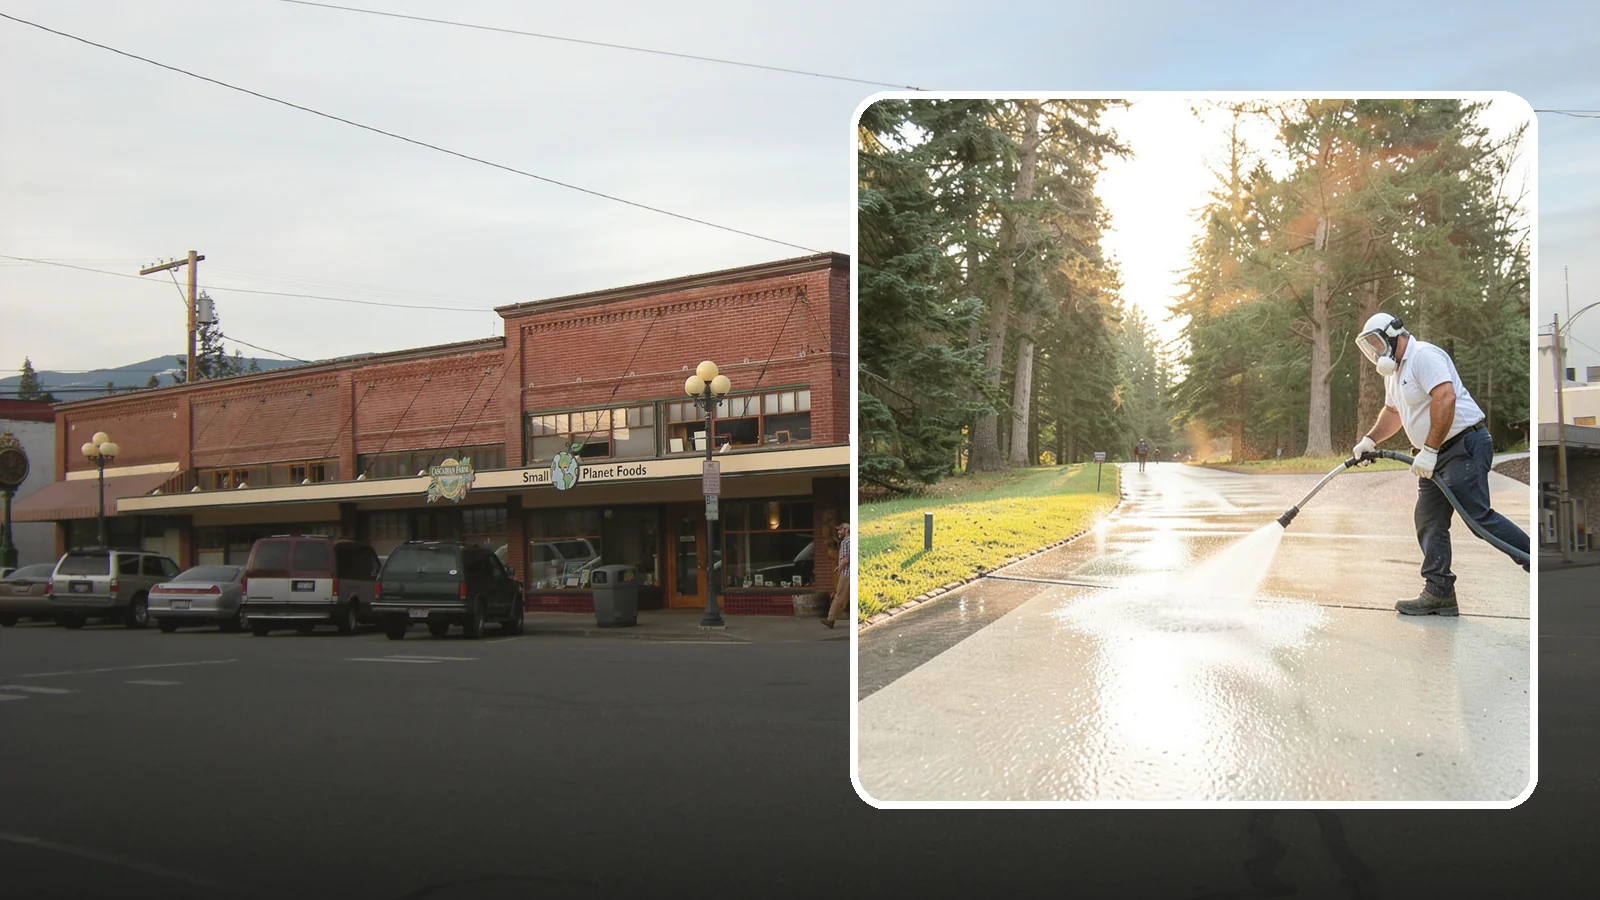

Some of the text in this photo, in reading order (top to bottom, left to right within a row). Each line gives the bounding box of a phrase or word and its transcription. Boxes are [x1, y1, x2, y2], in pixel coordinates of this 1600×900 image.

[431, 466, 456, 476] CASCADIAN
[523, 464, 647, 483] Small Planet Foods
